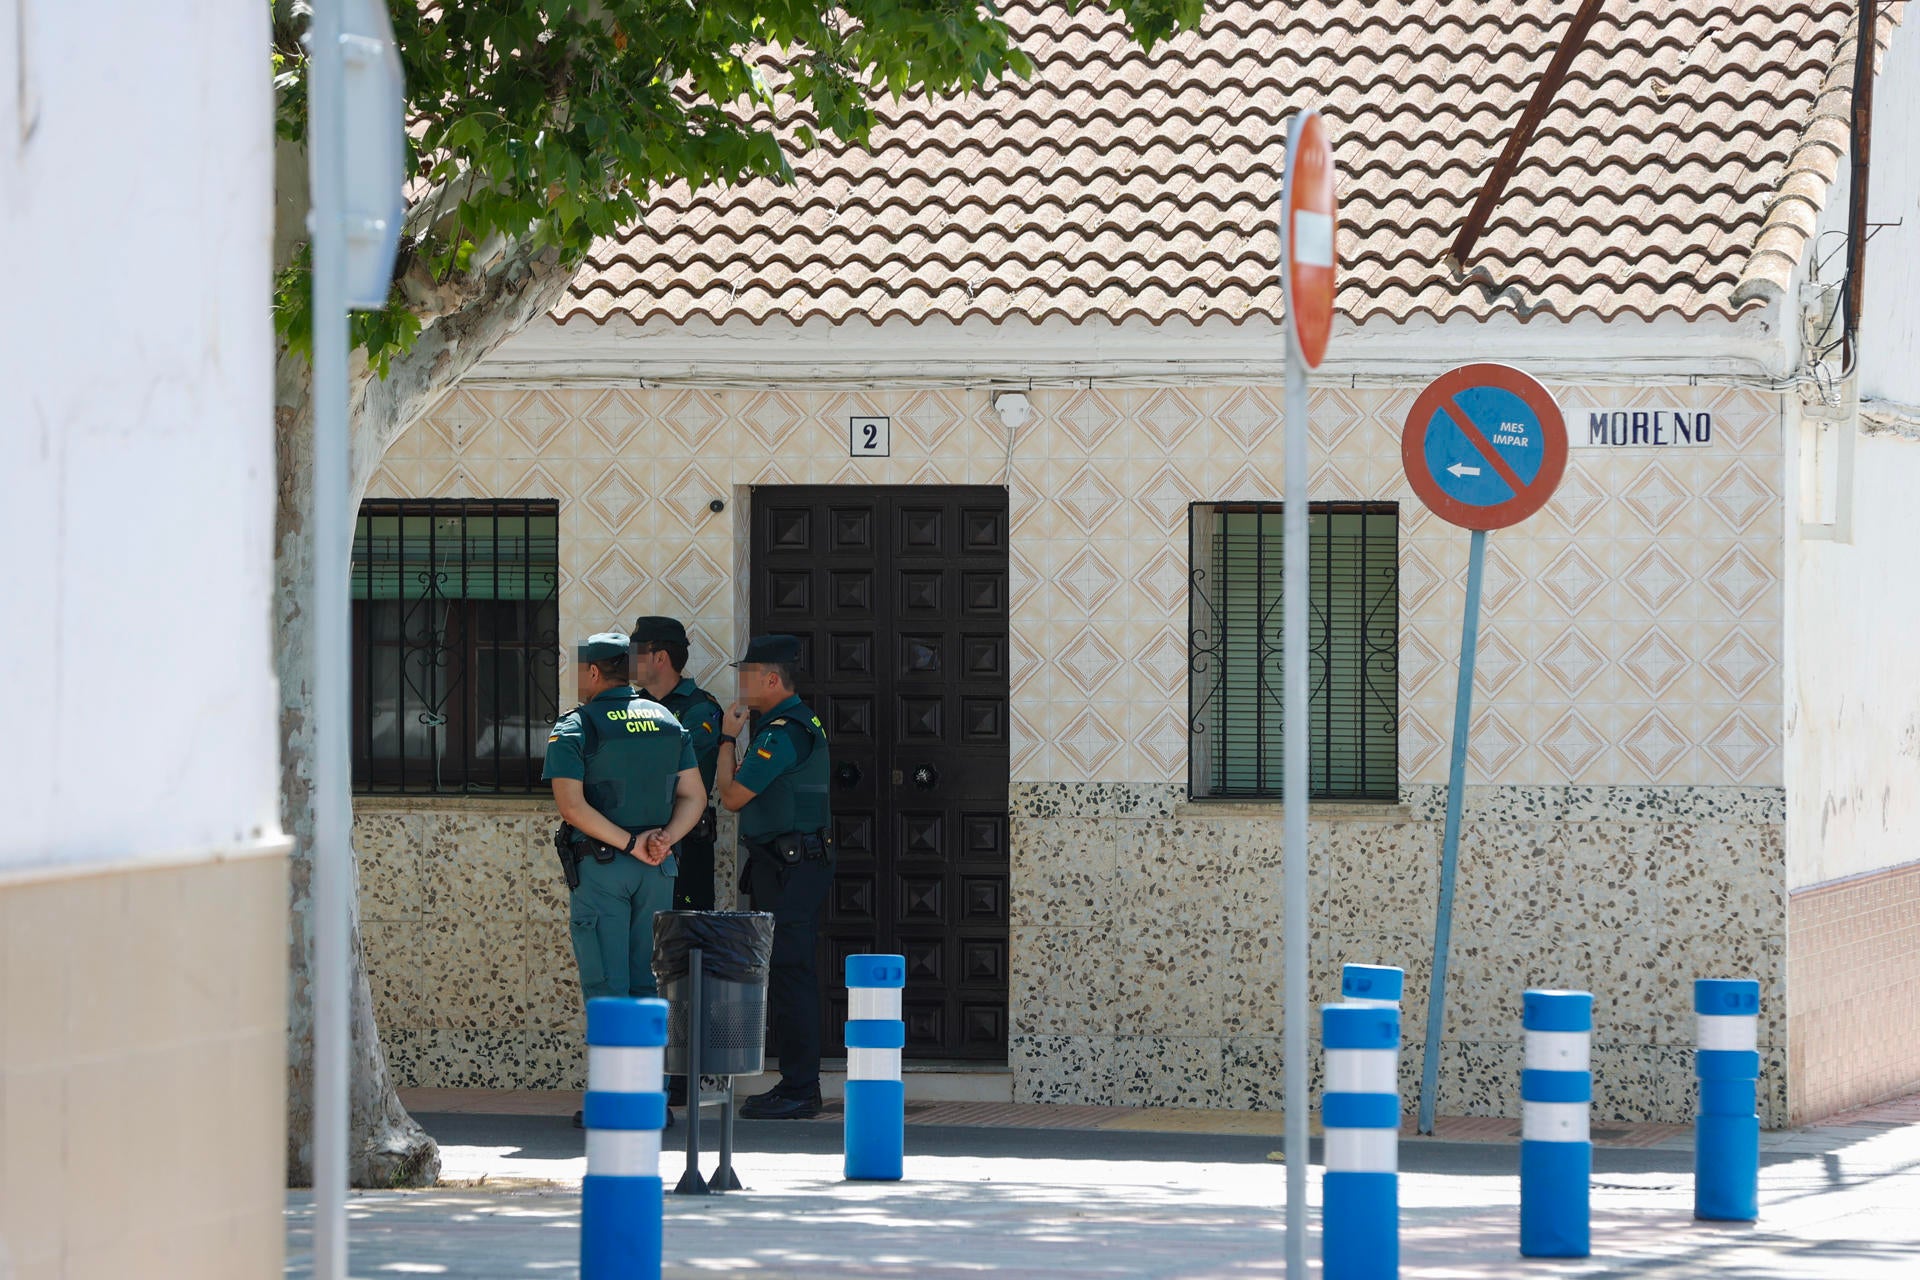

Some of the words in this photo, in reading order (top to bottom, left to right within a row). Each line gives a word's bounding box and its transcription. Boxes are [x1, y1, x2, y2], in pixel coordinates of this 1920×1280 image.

[1500, 422, 1525, 434] MES
[1590, 411, 1711, 446] MORENO
[863, 424, 877, 449] 2
[1493, 434, 1529, 447] IMPAR
[606, 708, 664, 720] GUARDIA
[626, 720, 660, 733] CIVIL
